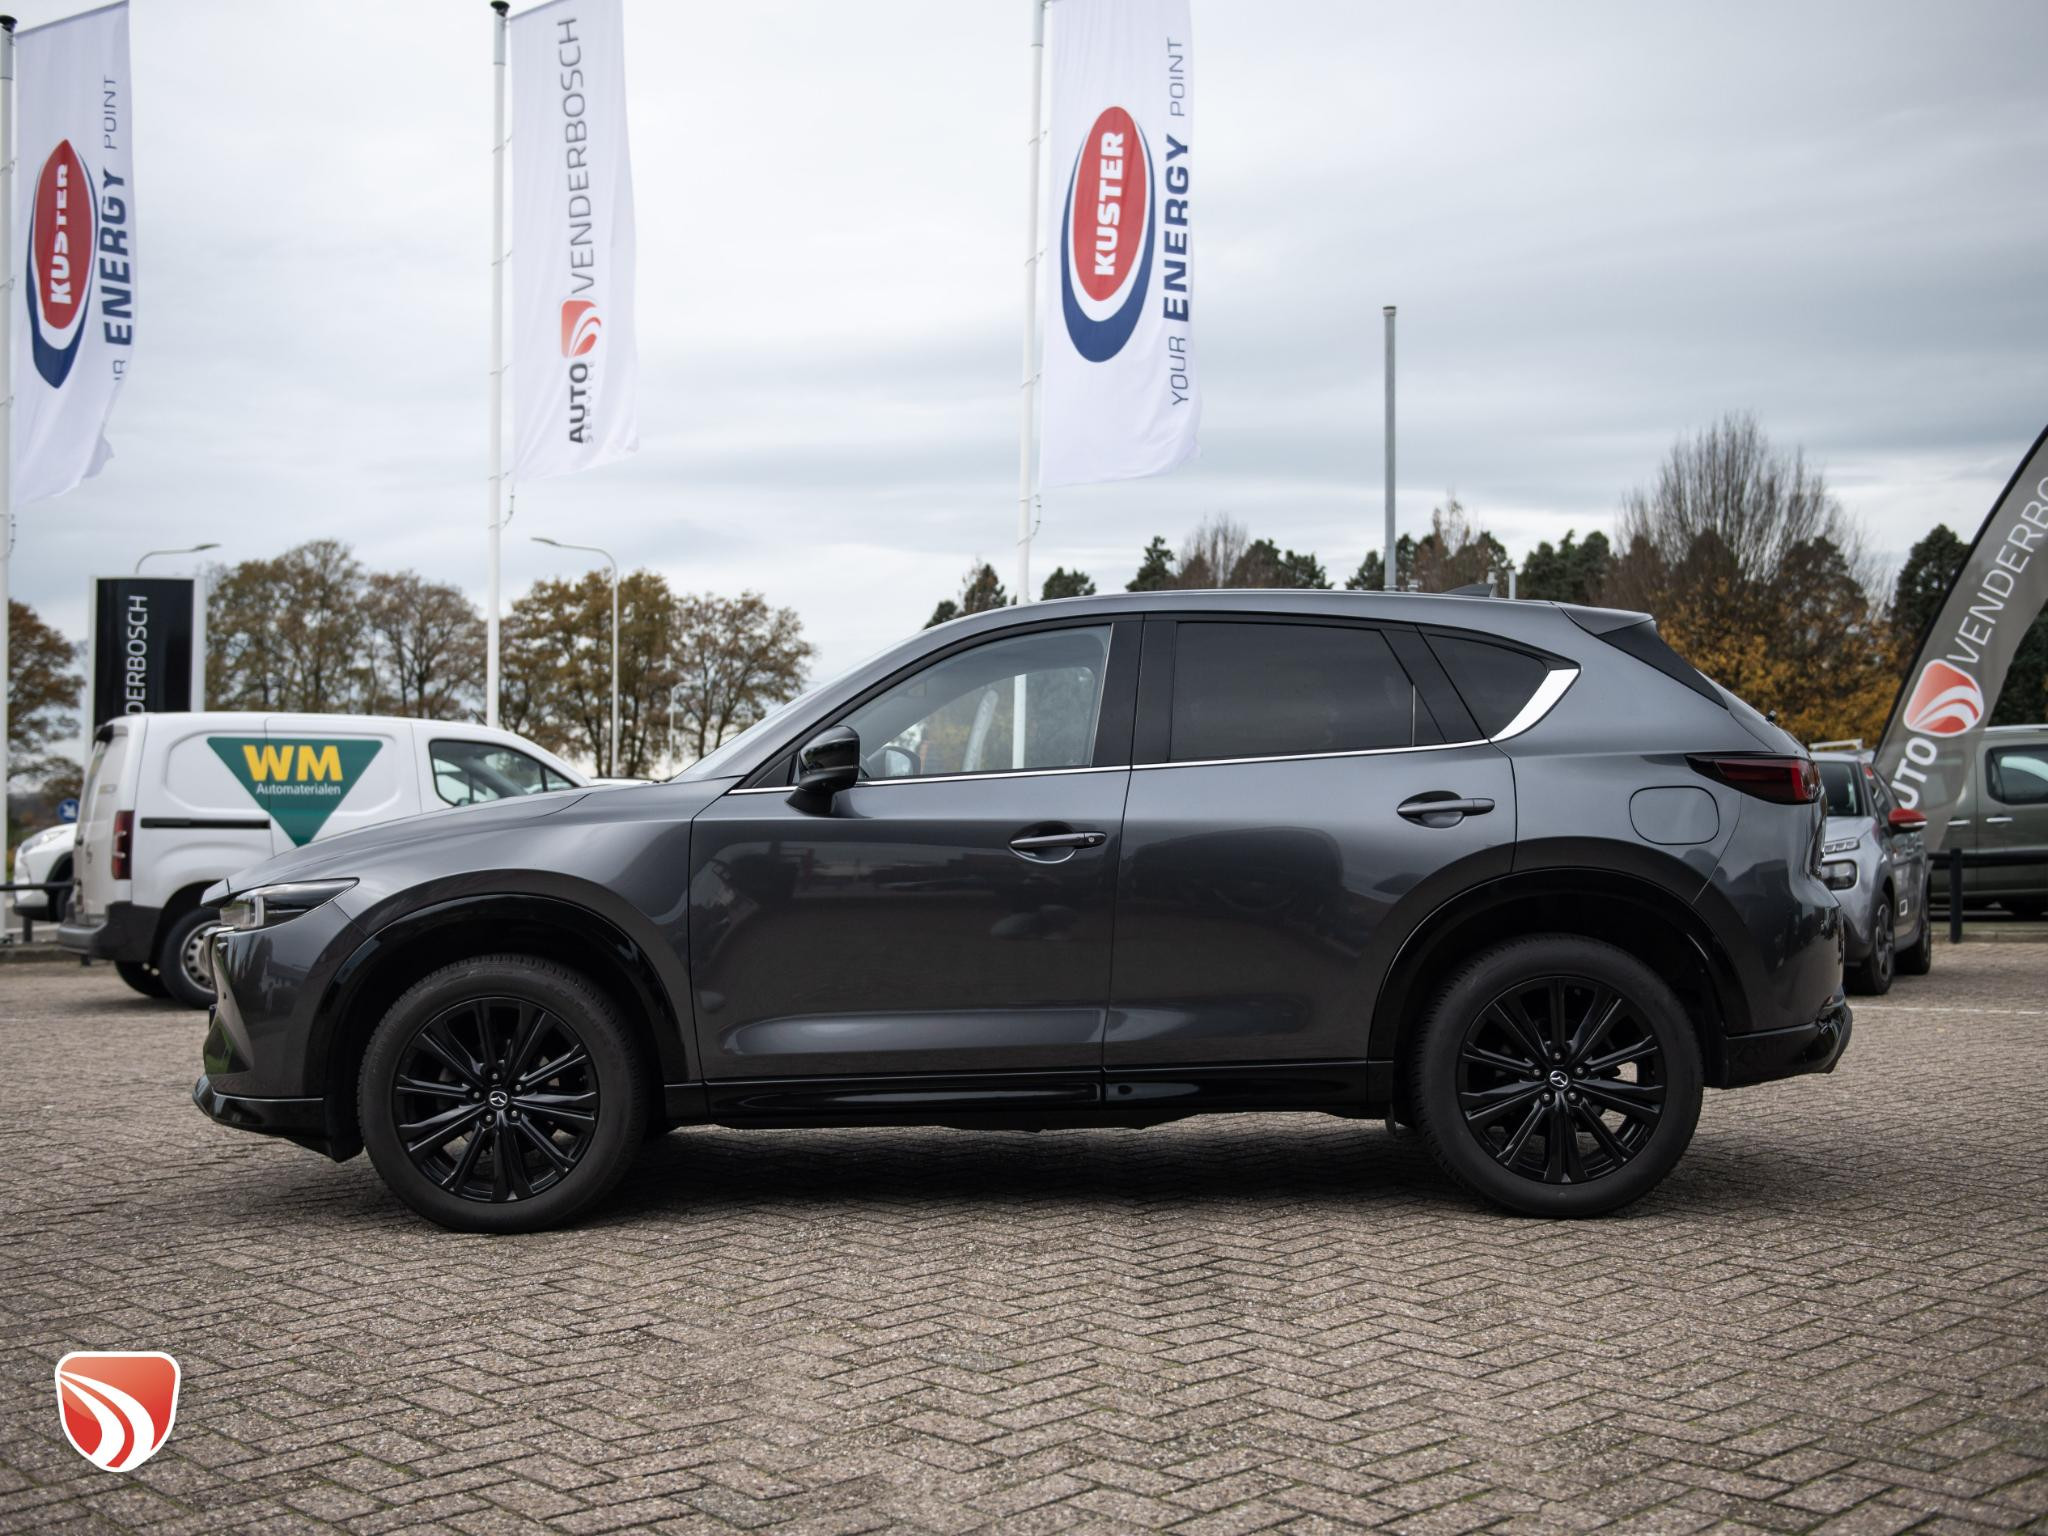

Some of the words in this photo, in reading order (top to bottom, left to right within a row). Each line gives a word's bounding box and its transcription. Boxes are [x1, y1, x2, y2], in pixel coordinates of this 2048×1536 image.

[103, 75, 118, 149] POINT
[1166, 36, 1185, 117] POINT
[557, 18, 595, 294] VENDERBOSCH
[50, 163, 72, 305] KUSTER
[1094, 132, 1124, 276] KUSTER
[1162, 133, 1189, 323] ENERGY
[99, 167, 132, 346] ENERGY
[569, 362, 588, 444] AUTO
[1168, 335, 1189, 406] YOUR
[242, 744, 343, 782] WM
[256, 783, 341, 795] Automaterialen
